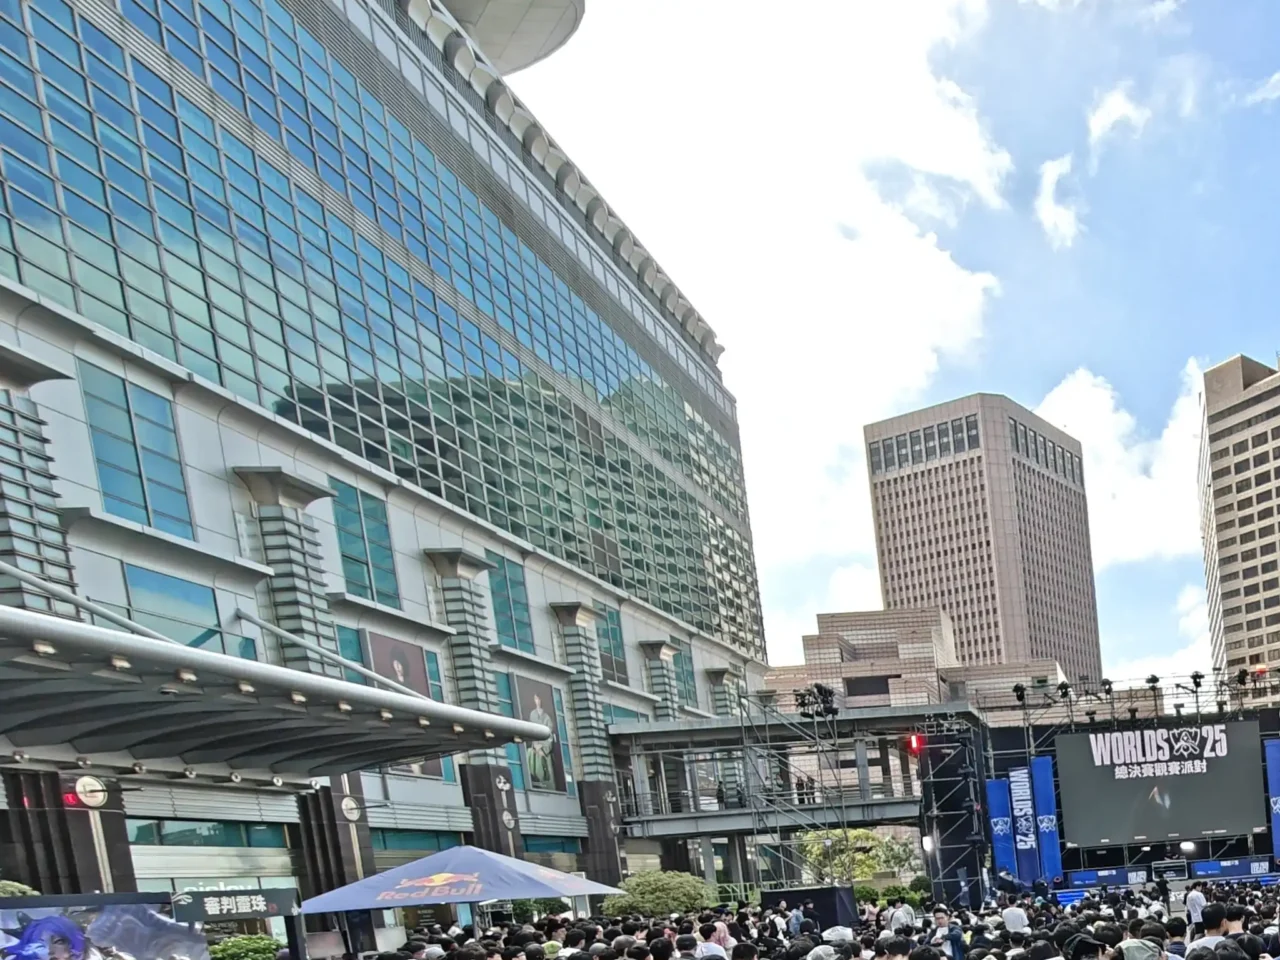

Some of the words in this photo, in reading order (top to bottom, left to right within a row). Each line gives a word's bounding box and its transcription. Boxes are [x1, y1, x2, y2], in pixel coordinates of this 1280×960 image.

[1089, 728, 1170, 766] WORLDS
[1202, 724, 1228, 758] 25
[1114, 759, 1207, 779] 總決賽觀賽派對
[1009, 769, 1034, 817] WORLDS
[1016, 834, 1036, 850] 25
[376, 887, 430, 901] Red
[431, 883, 483, 897] Bull
